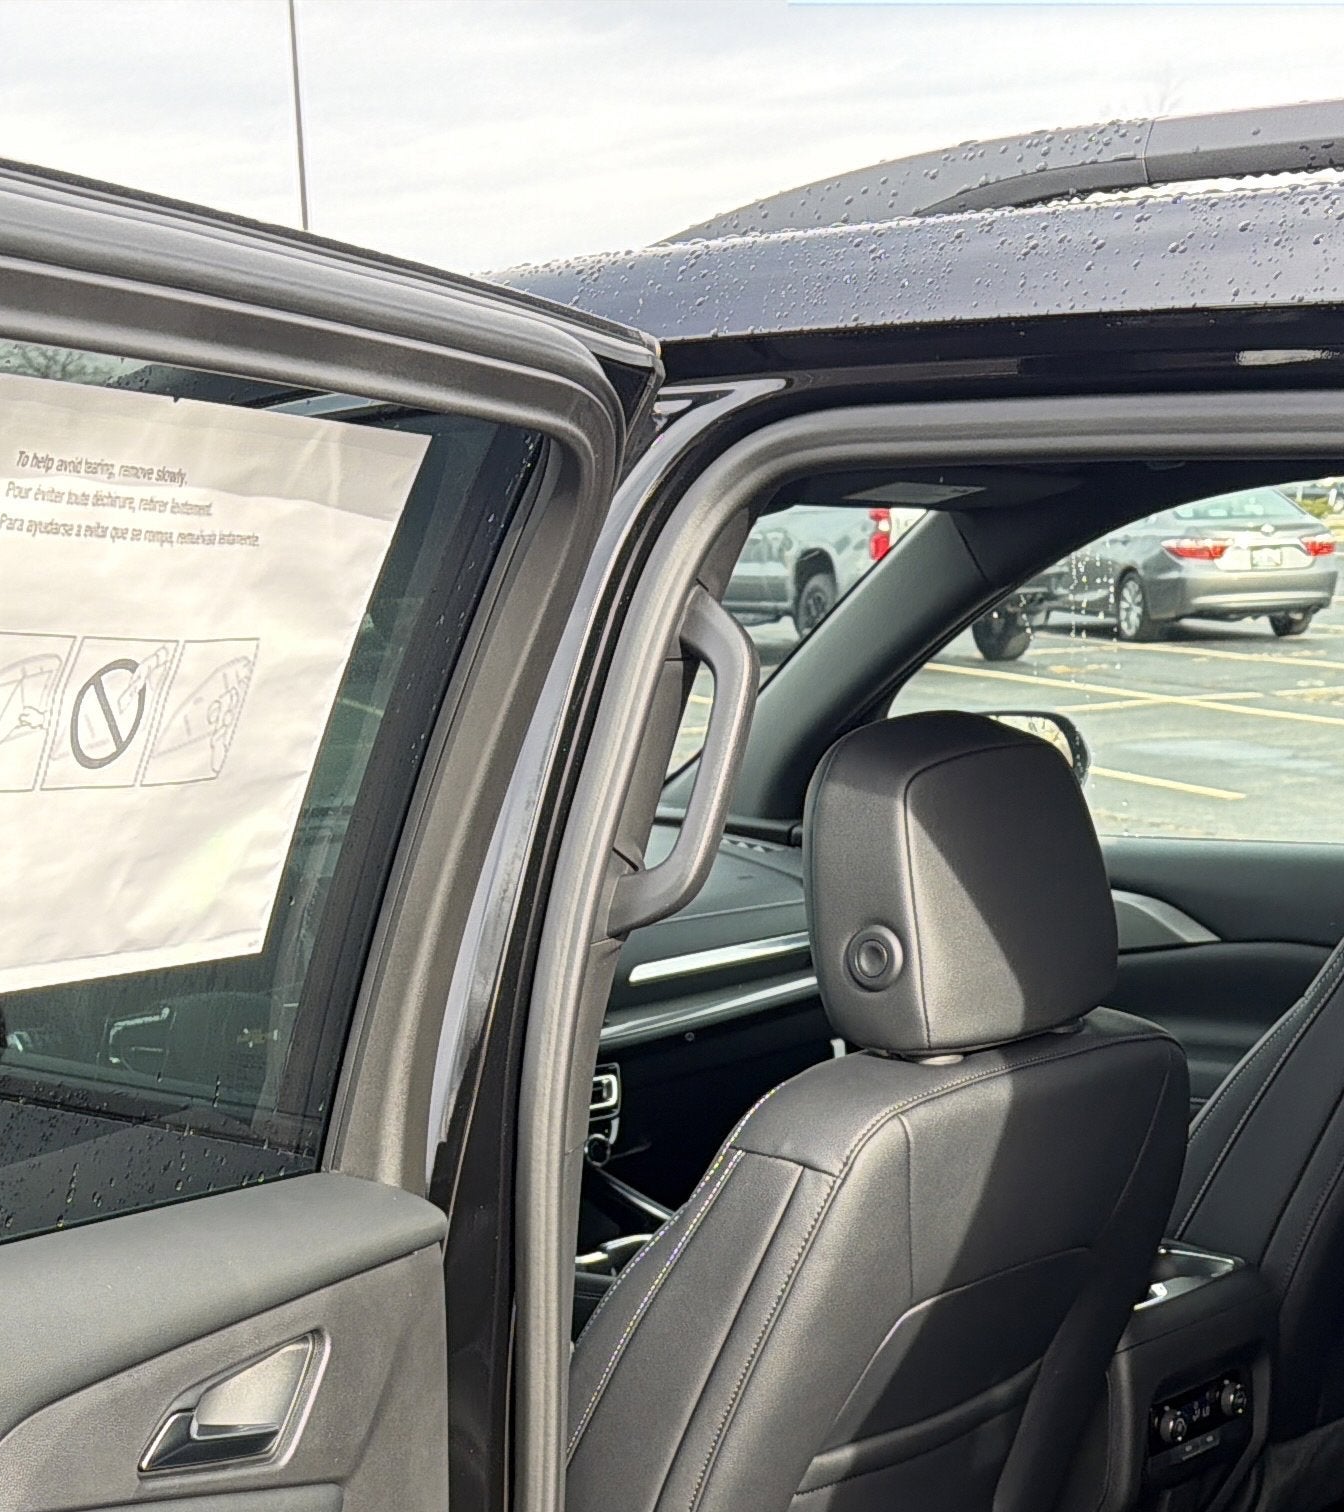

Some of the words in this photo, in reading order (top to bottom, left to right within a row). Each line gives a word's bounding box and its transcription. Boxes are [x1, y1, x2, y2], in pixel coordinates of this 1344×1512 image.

[16, 450, 29, 468] To
[30, 453, 54, 474] help
[56, 457, 83, 474] avoid
[118, 464, 154, 481] remove
[155, 466, 188, 488] slowly.
[6, 481, 33, 499] Pour
[0, 513, 24, 531] Para
[110, 526, 129, 543] que
